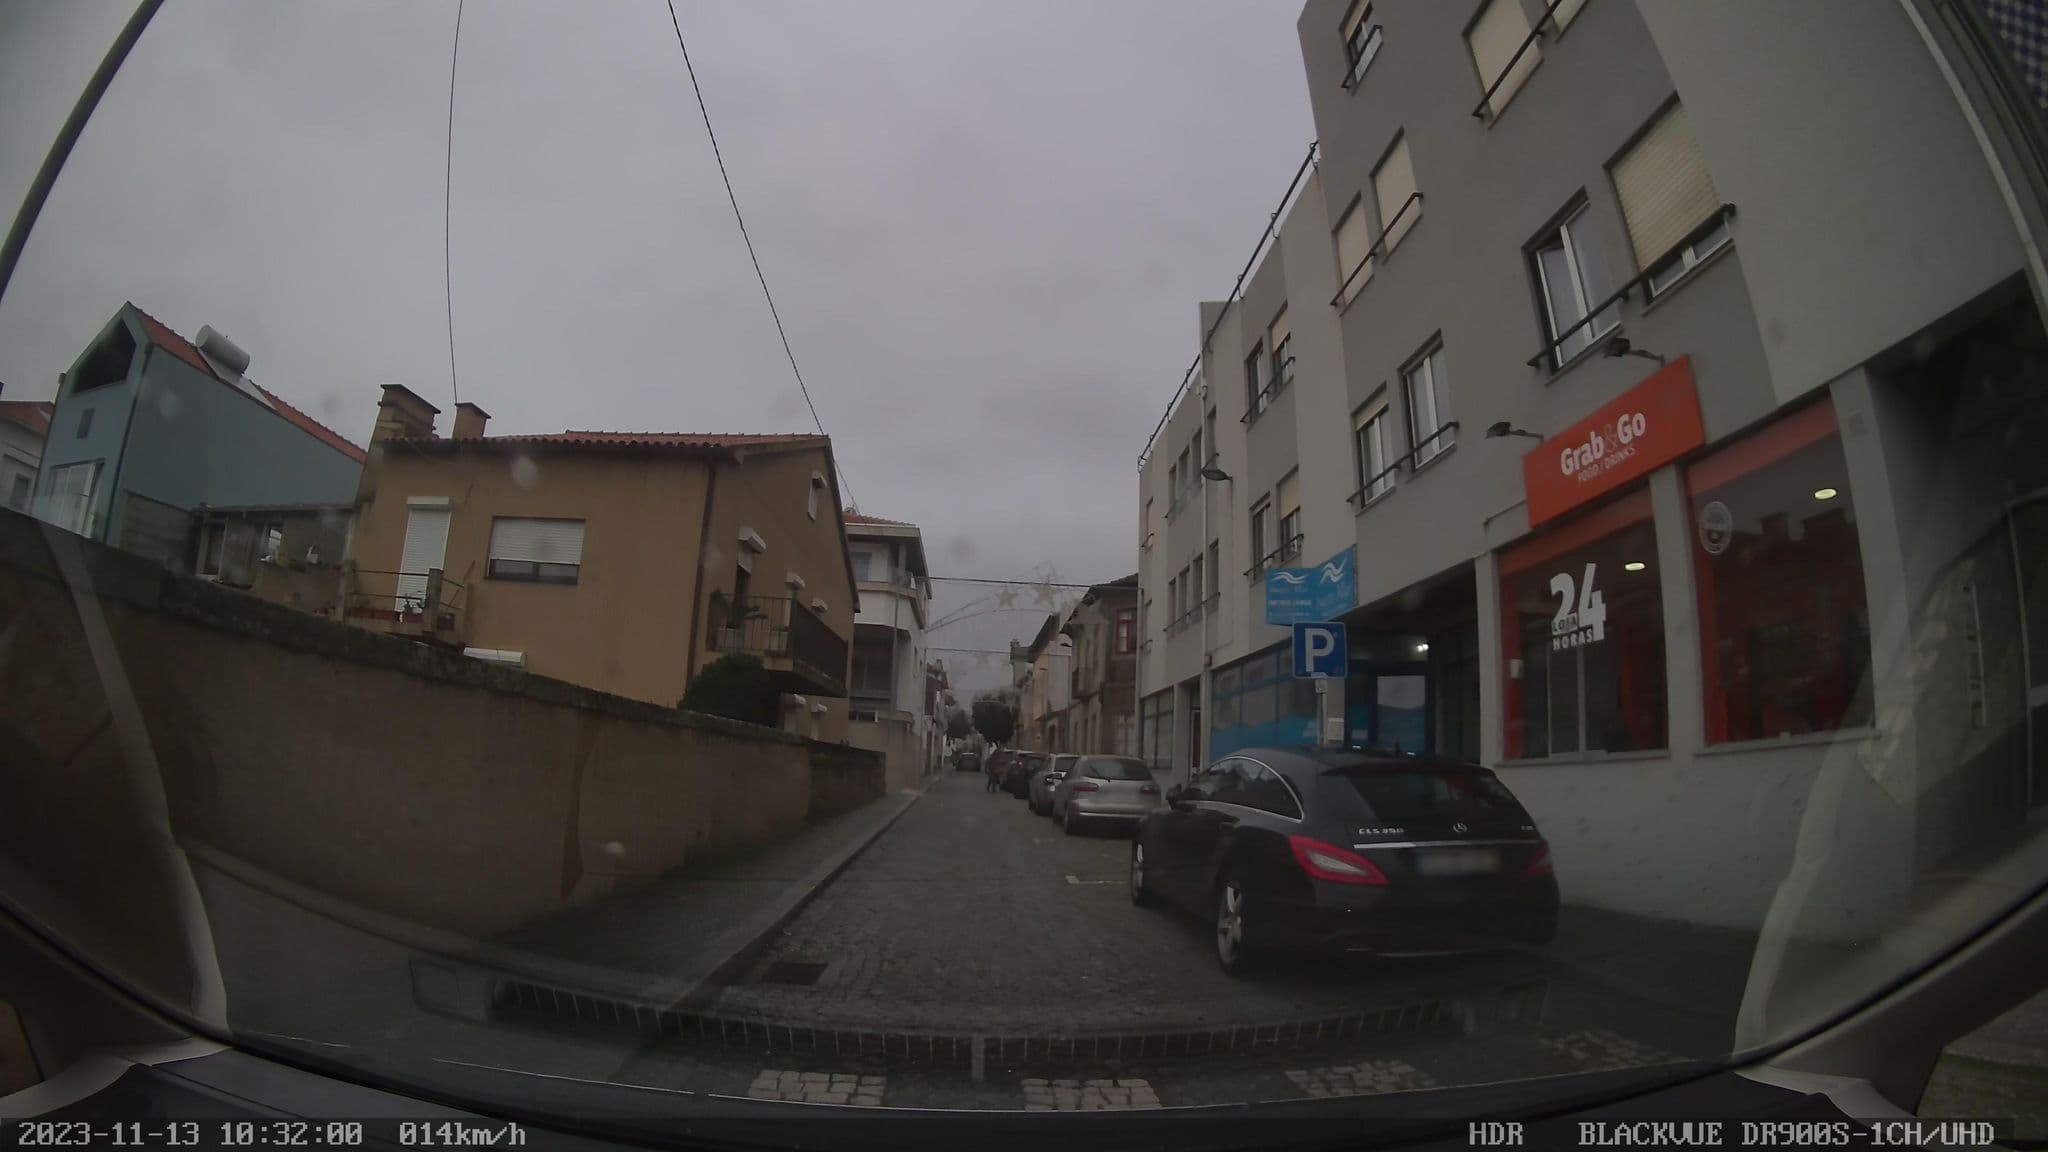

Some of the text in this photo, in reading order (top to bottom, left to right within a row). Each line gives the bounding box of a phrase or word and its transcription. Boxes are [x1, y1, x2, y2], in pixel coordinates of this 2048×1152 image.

[1560, 412, 1646, 475] Grab&Go
[1577, 463, 1600, 482] FOOD
[1550, 563, 1606, 641] 24
[1305, 627, 1335, 672] P
[1552, 628, 1593, 651] HORAS
[1358, 827, 1381, 835] CLS
